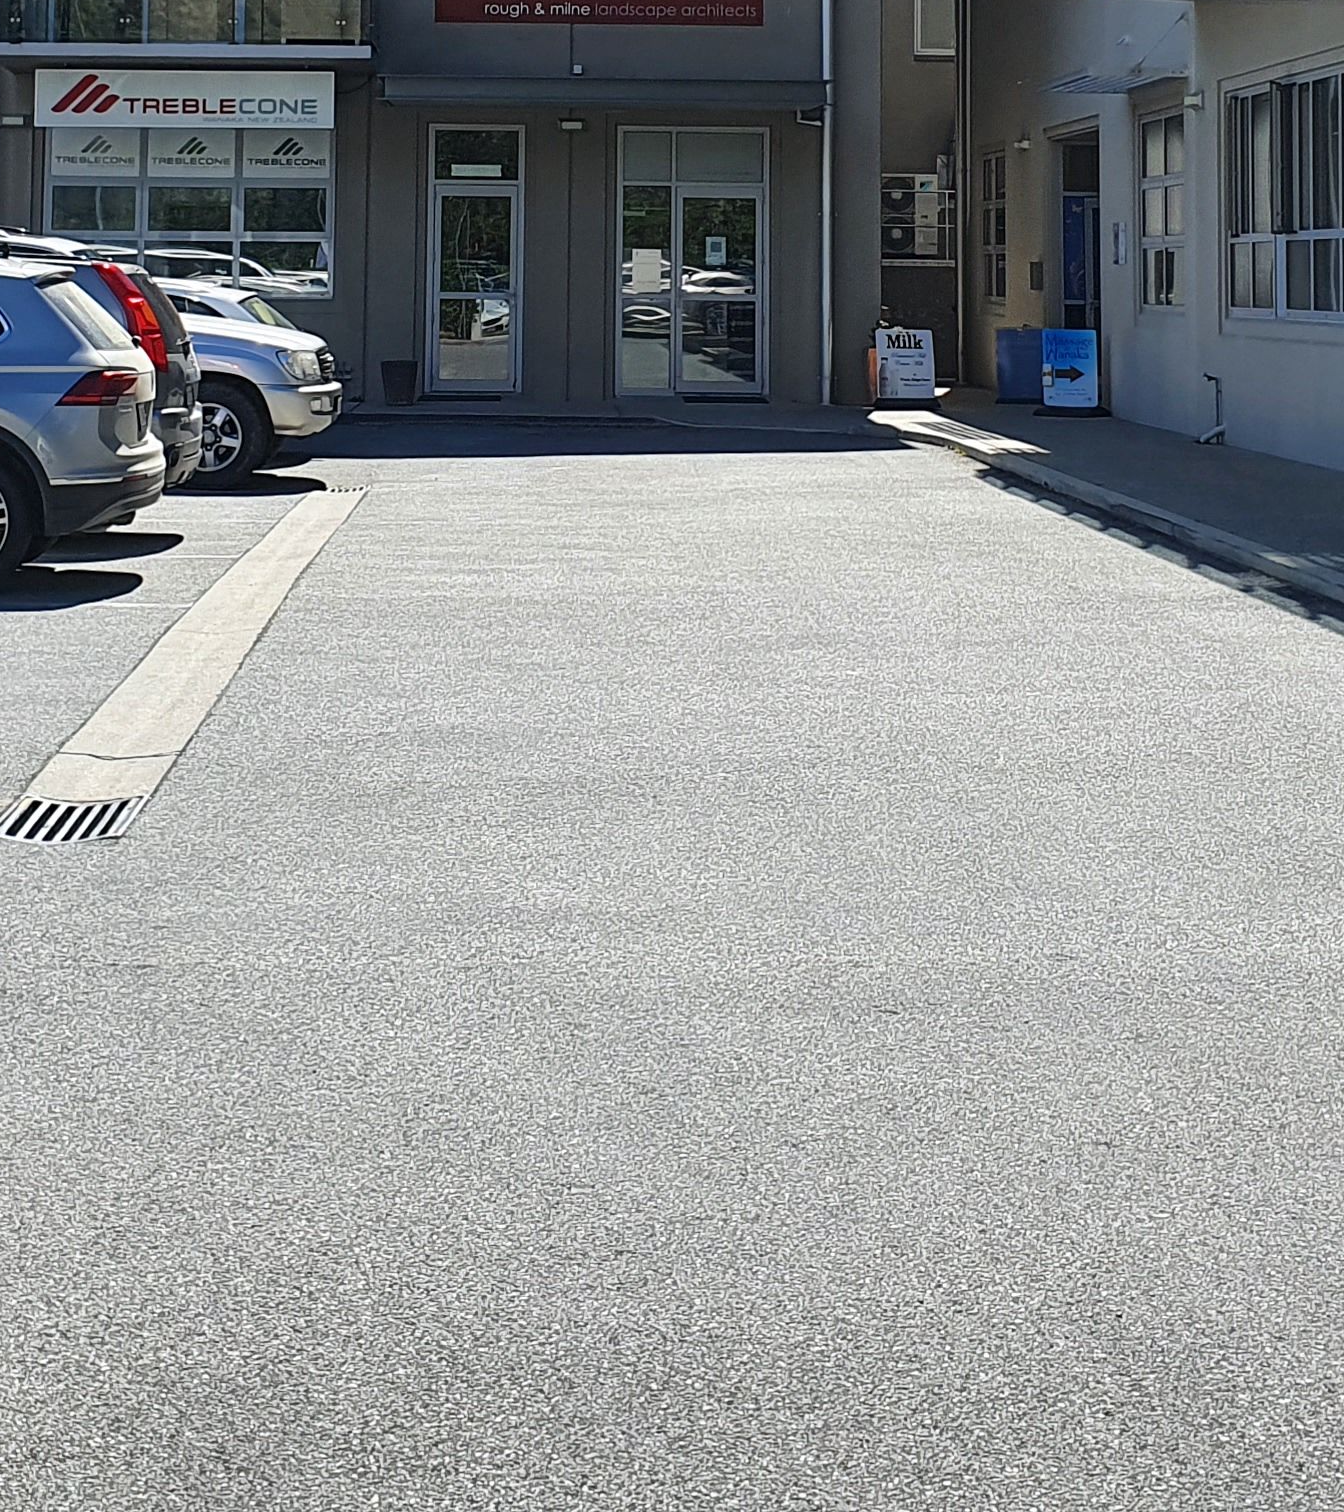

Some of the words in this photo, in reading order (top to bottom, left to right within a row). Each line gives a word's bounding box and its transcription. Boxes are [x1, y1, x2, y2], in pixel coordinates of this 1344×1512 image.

[484, 1, 529, 18] rough
[534, 2, 545, 16] &
[550, 2, 591, 16] milne
[595, 2, 677, 20] landscape
[681, 2, 757, 17] architects
[122, 97, 318, 115] TREBLECONE
[886, 332, 924, 349] Milk
